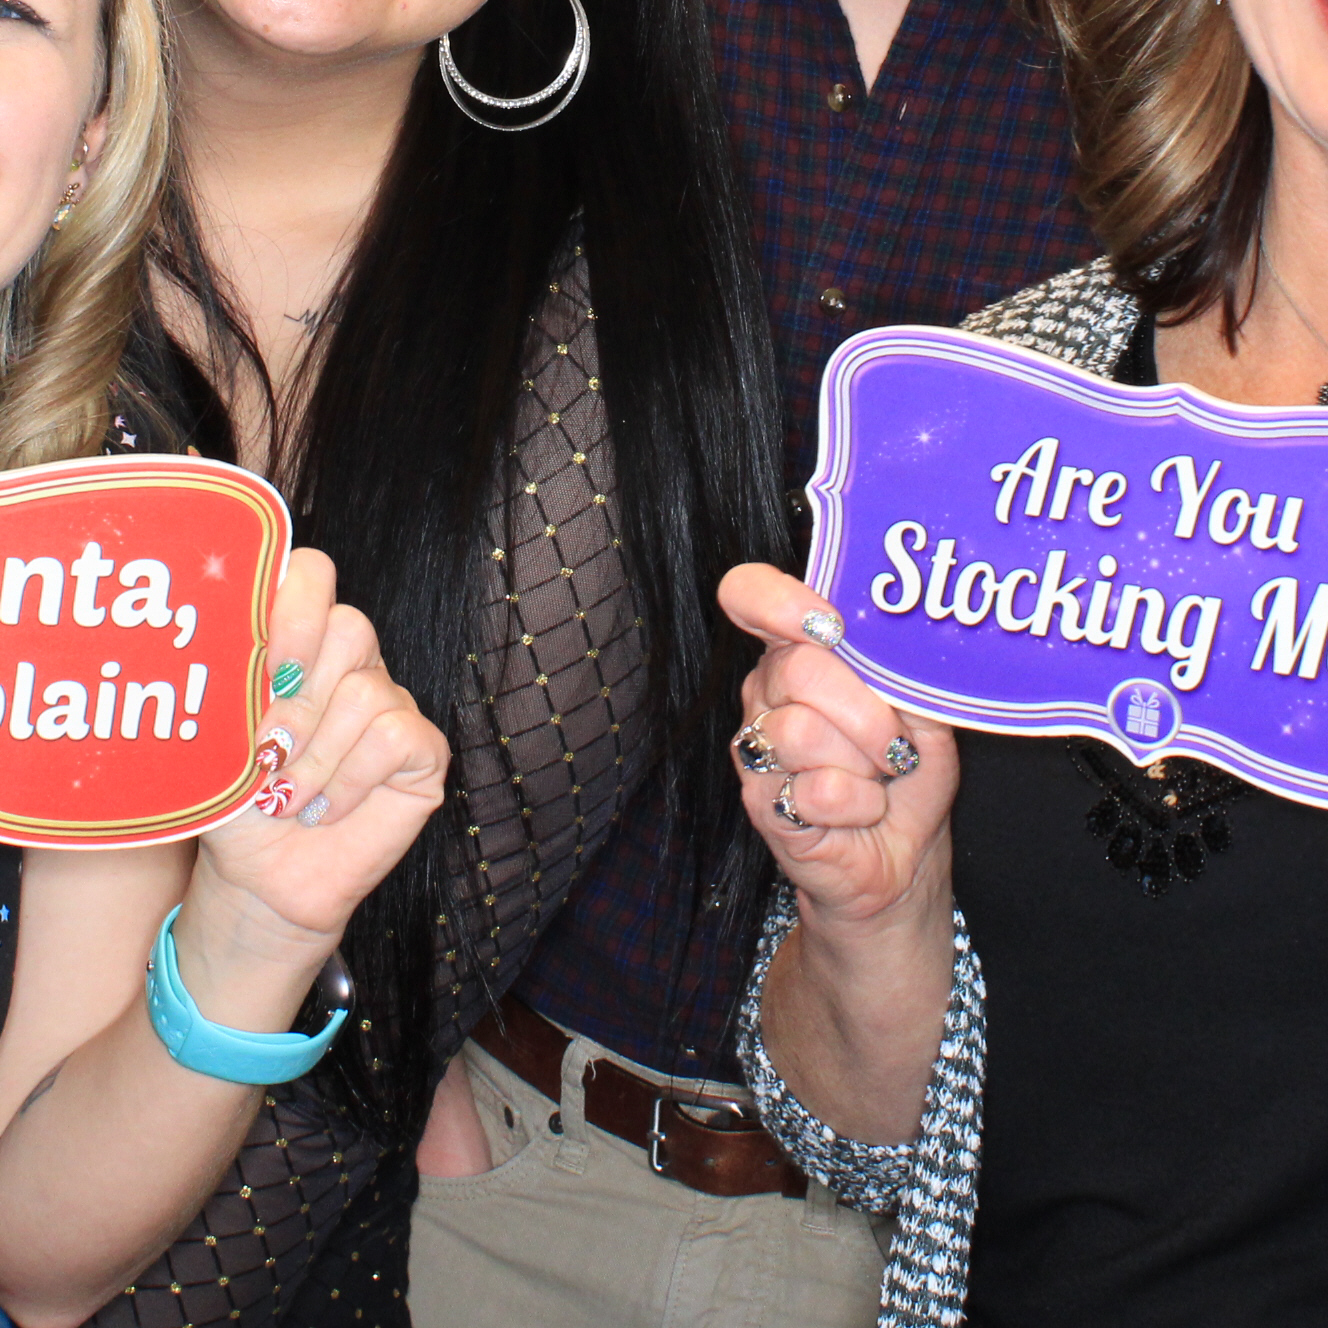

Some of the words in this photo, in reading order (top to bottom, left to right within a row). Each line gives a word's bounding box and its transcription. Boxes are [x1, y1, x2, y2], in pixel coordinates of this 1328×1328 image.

[990, 436, 1128, 527] Are
[1149, 454, 1305, 554] You
[869, 519, 1223, 692] Stocking
